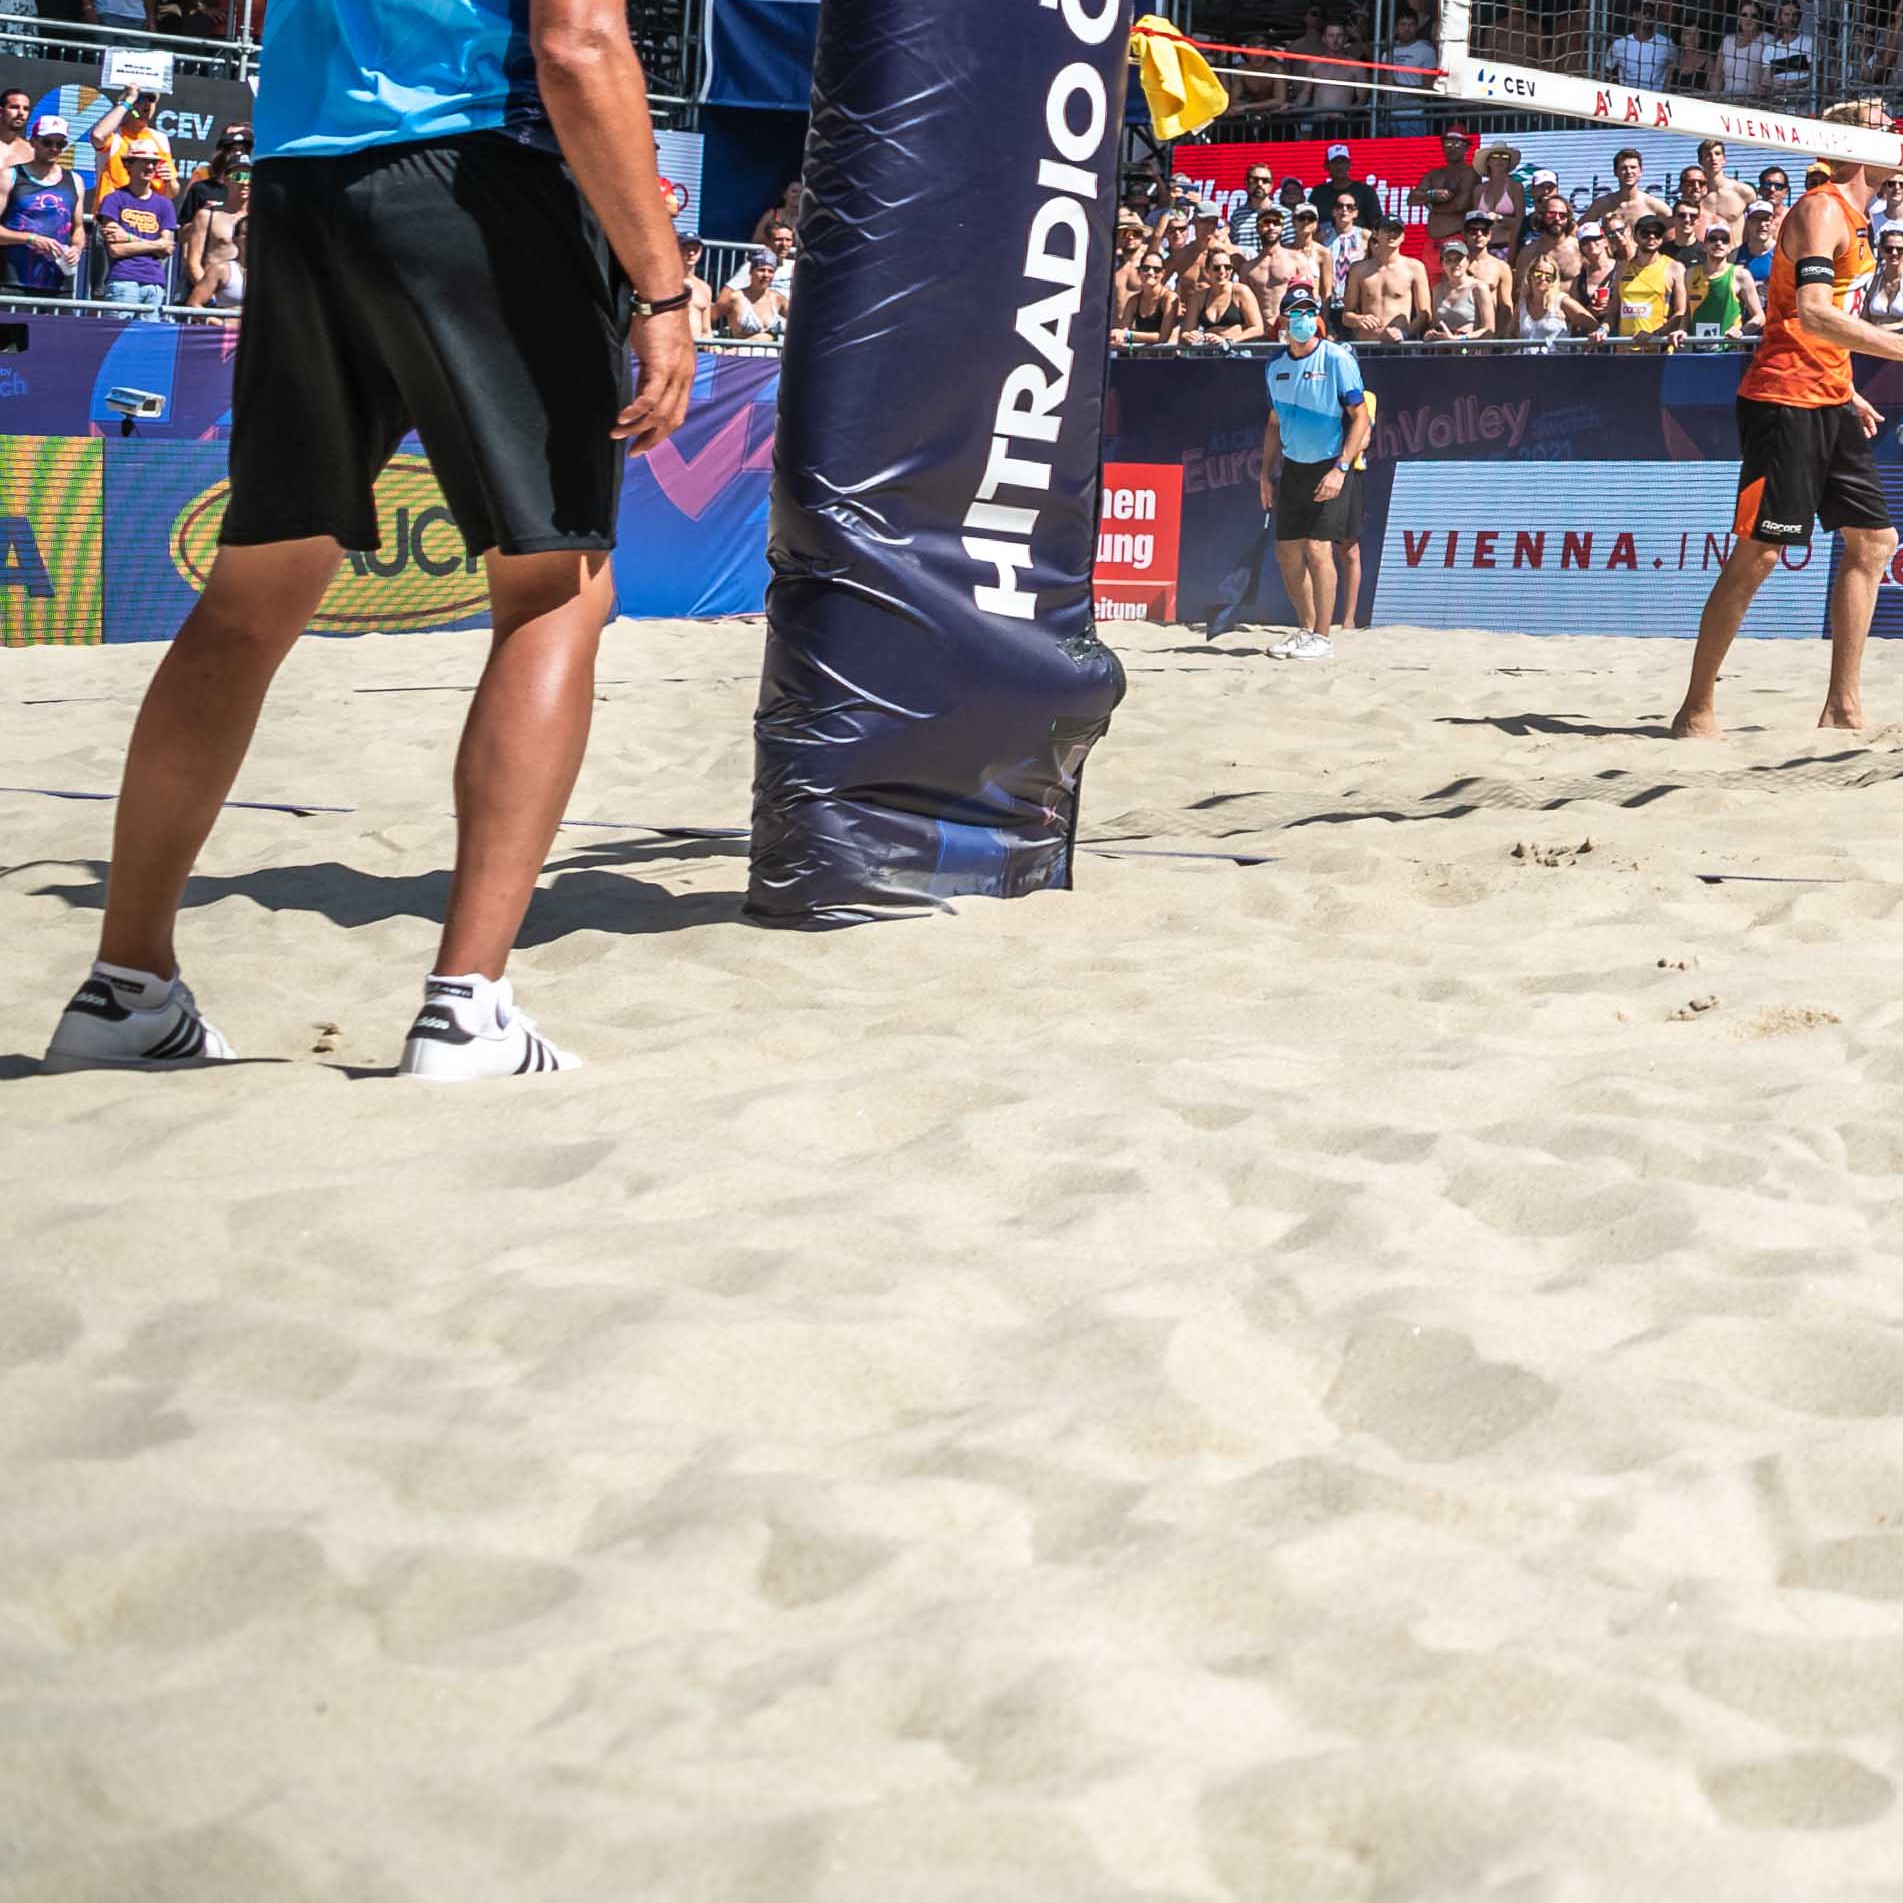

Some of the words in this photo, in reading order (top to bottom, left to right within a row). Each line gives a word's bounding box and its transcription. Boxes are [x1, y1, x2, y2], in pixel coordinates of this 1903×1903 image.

[1504, 77, 1536, 98] CEV
[1593, 89, 1613, 117] A1
[1623, 94, 1642, 122] A1
[1653, 99, 1672, 127] A1
[156, 110, 214, 141] CEV
[960, 61, 1107, 620] HITRADIO
[1761, 519, 1803, 535] ARCADE
[1403, 529, 1813, 572] VIENNA.INO
